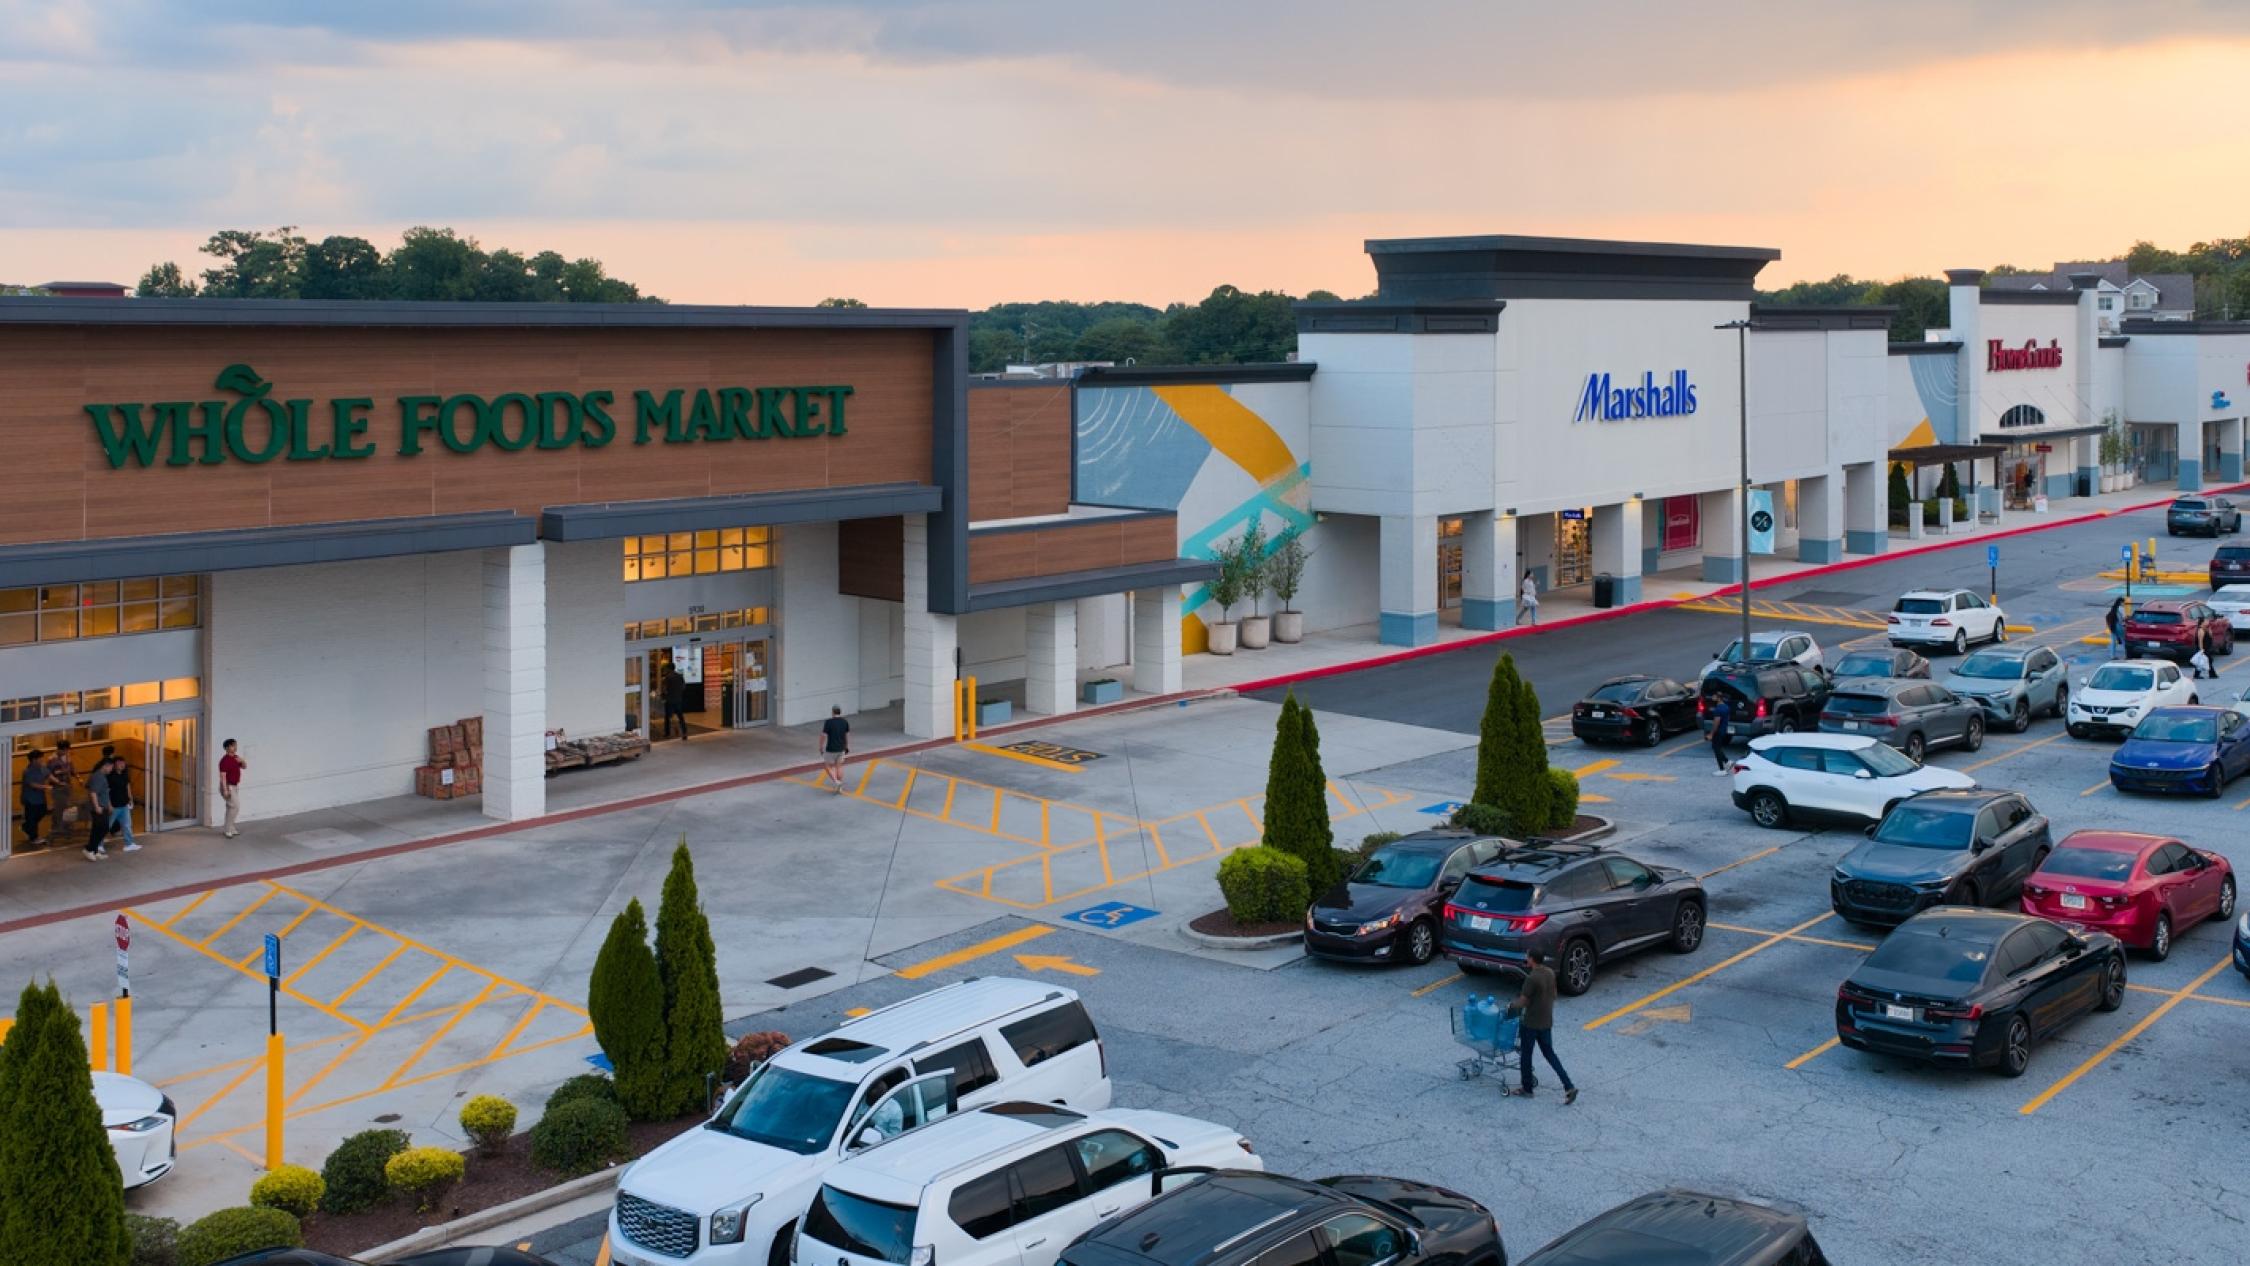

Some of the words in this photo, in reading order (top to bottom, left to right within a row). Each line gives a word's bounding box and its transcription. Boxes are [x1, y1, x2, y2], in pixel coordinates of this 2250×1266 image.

[1986, 337, 2063, 373] HomeGoods
[1574, 369, 1698, 423] Marshalls
[84, 397, 376, 469] WHOLE
[396, 391, 617, 456] FOODS
[633, 385, 854, 444] MARKET
